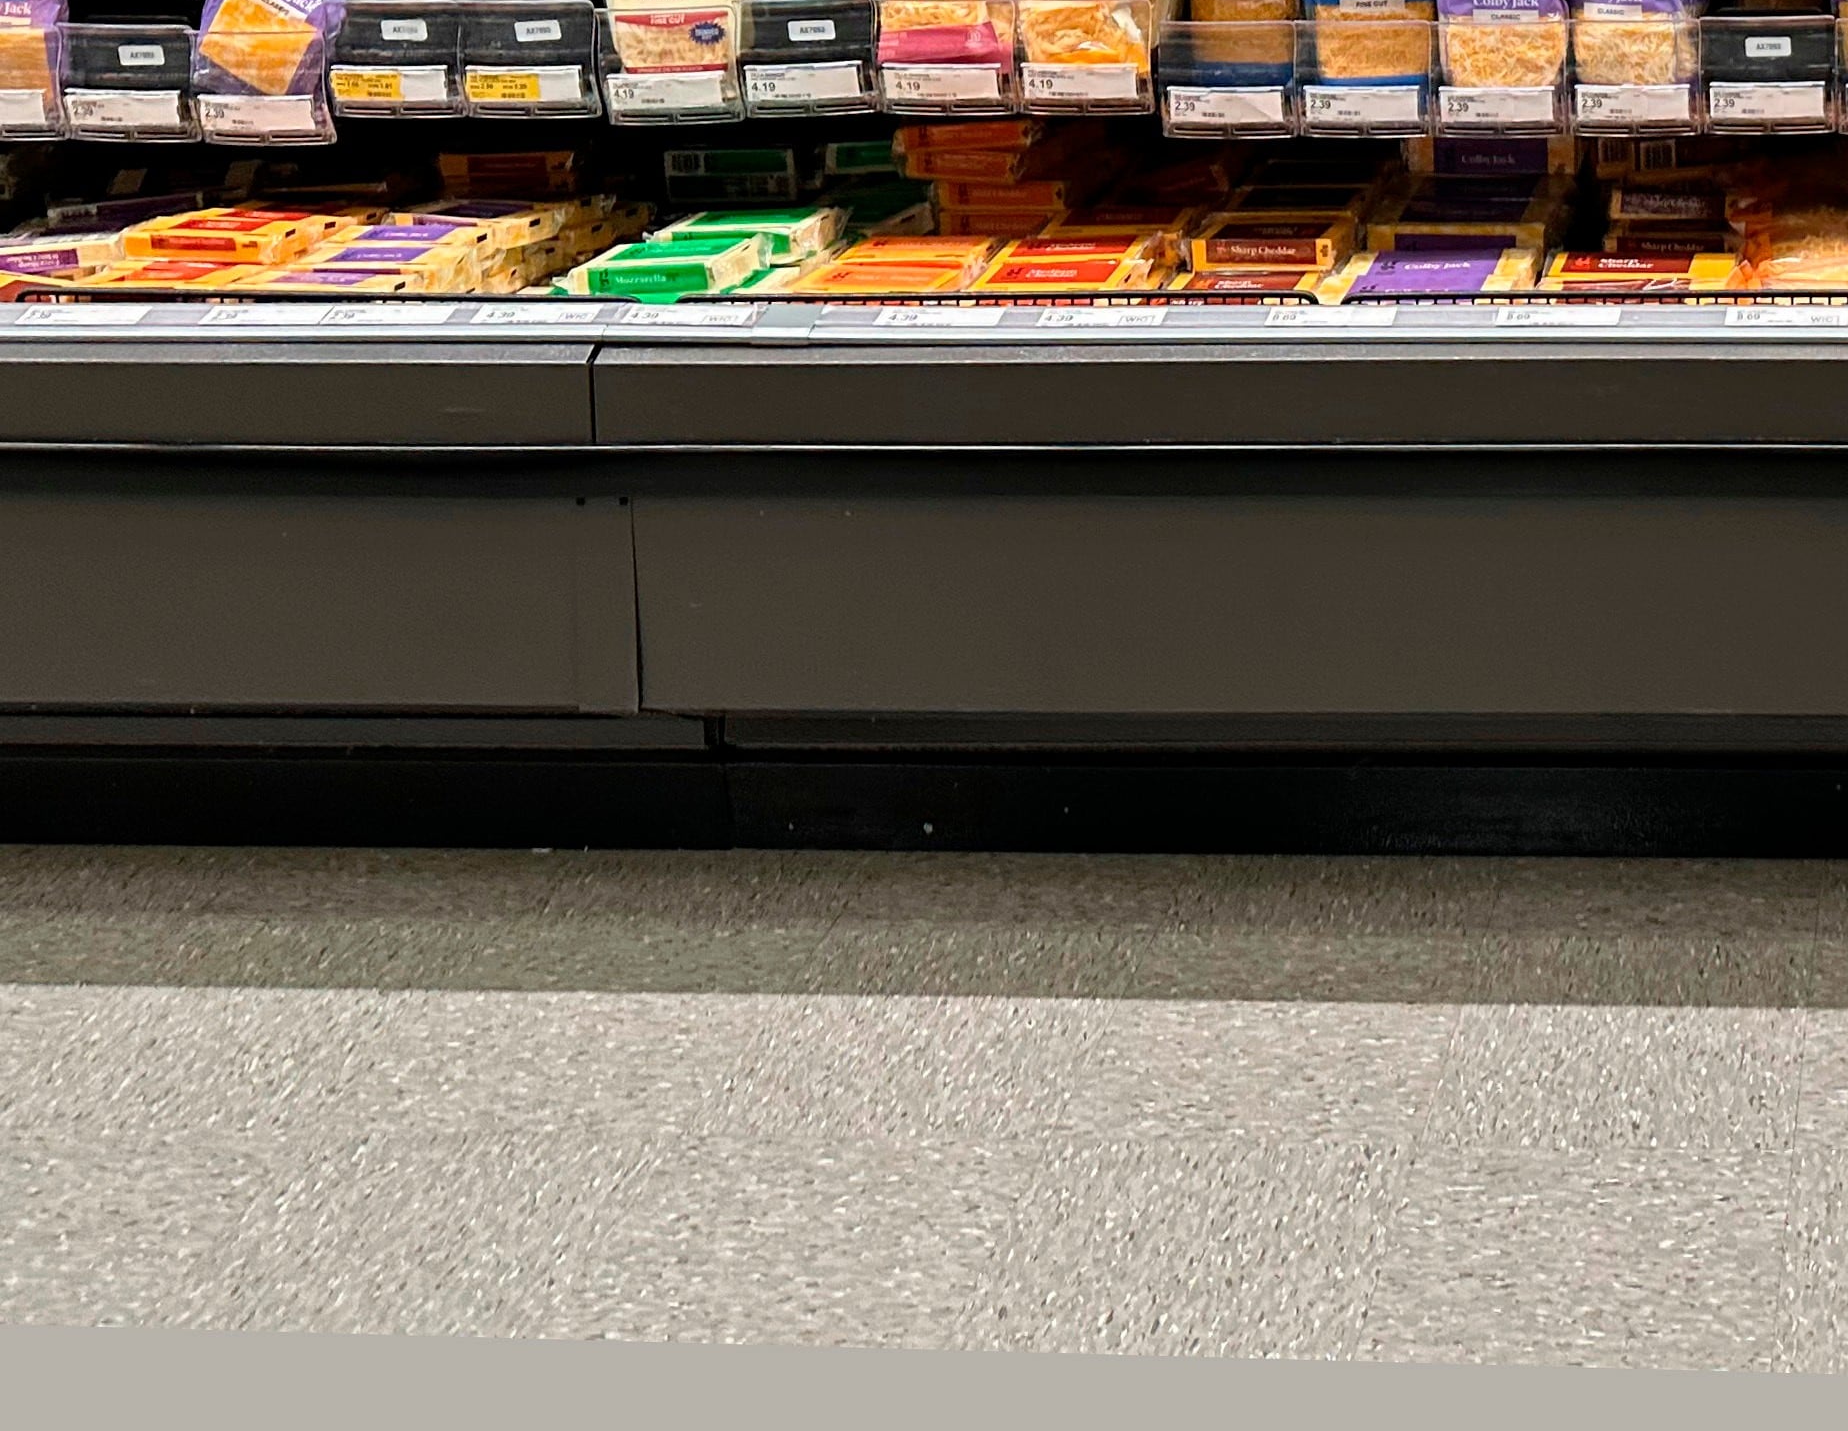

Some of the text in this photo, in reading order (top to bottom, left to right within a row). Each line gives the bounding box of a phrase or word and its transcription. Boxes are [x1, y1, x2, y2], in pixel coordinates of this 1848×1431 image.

[896, 80, 921, 91] 4.19
[614, 88, 635, 99] 4.19
[1448, 102, 1469, 112] 2.39
[1230, 245, 1298, 257] Sharp Cheddar
[615, 274, 667, 284] Mozzarella
